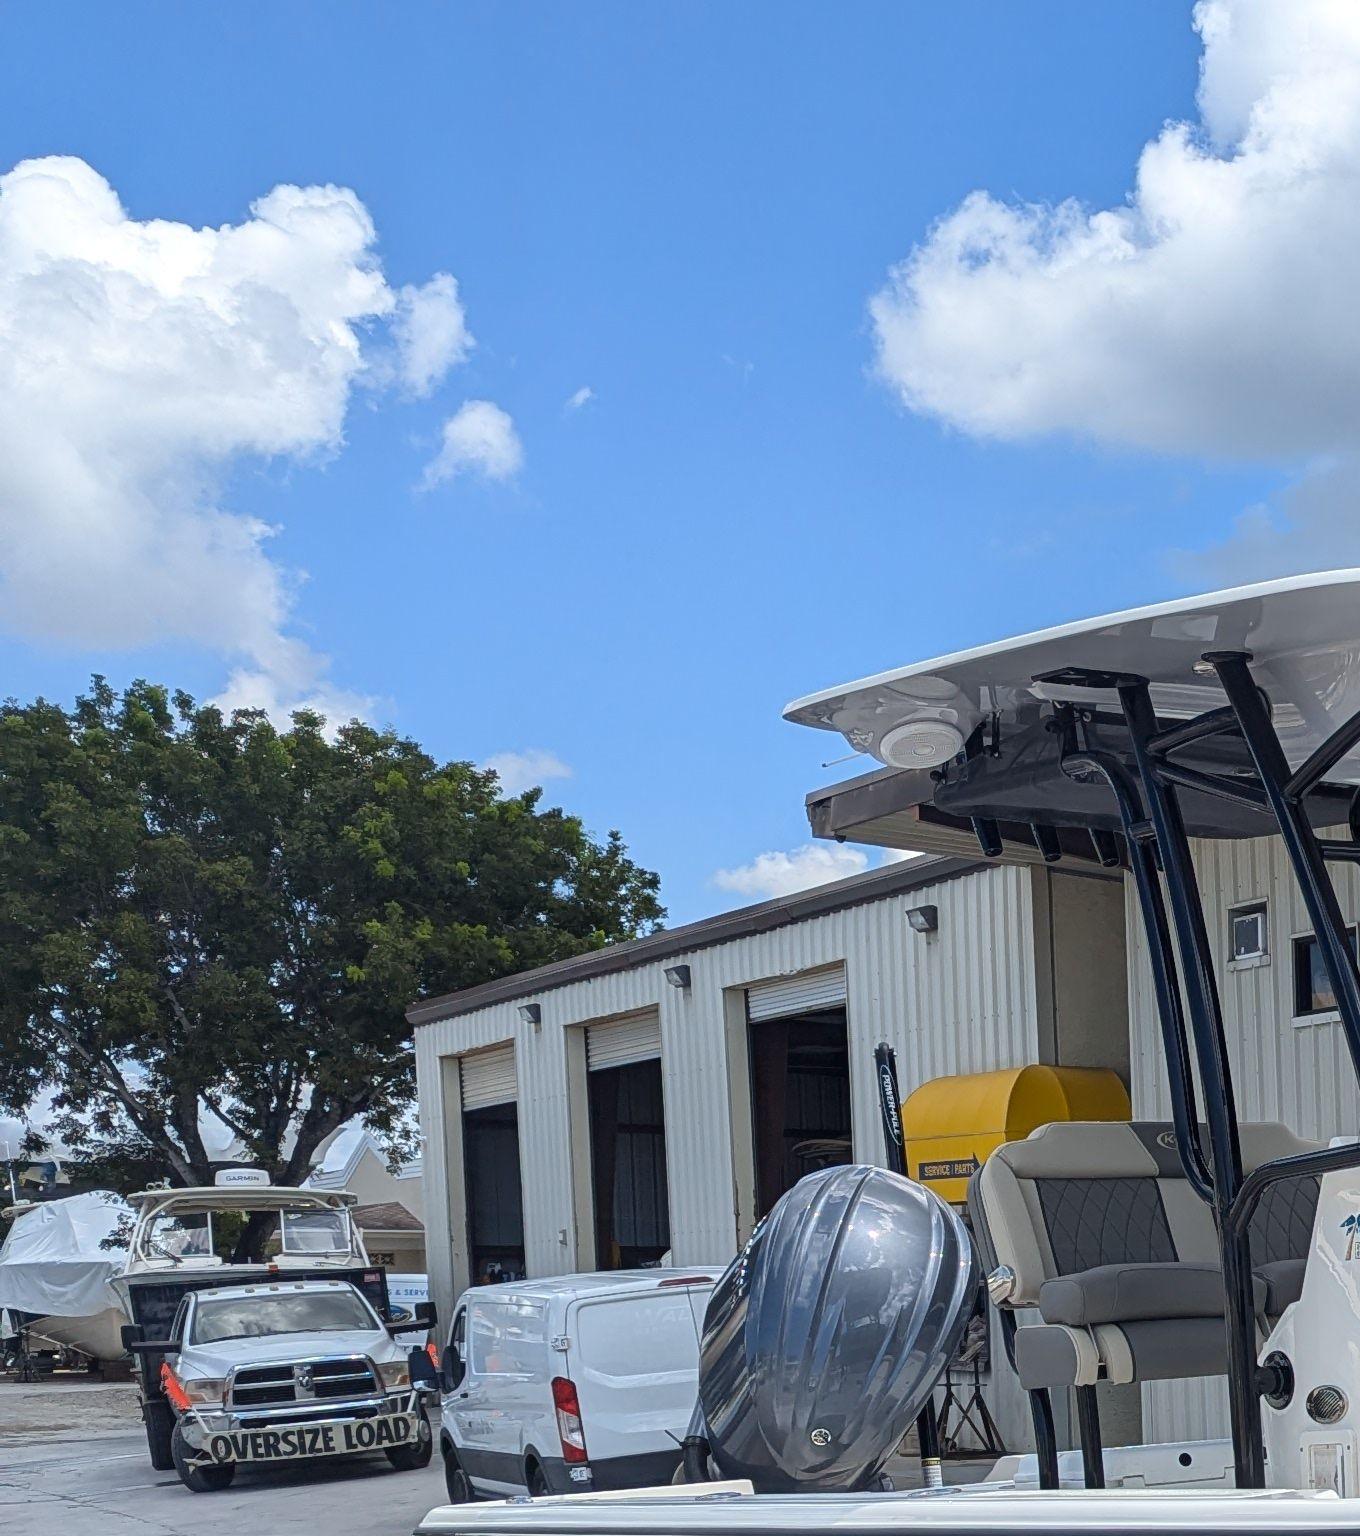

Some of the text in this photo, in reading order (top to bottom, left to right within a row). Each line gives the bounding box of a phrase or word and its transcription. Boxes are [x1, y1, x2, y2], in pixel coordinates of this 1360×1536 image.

[924, 1165, 951, 1177] SERVICE
[210, 1416, 411, 1463] OVERSIZE LOAD
